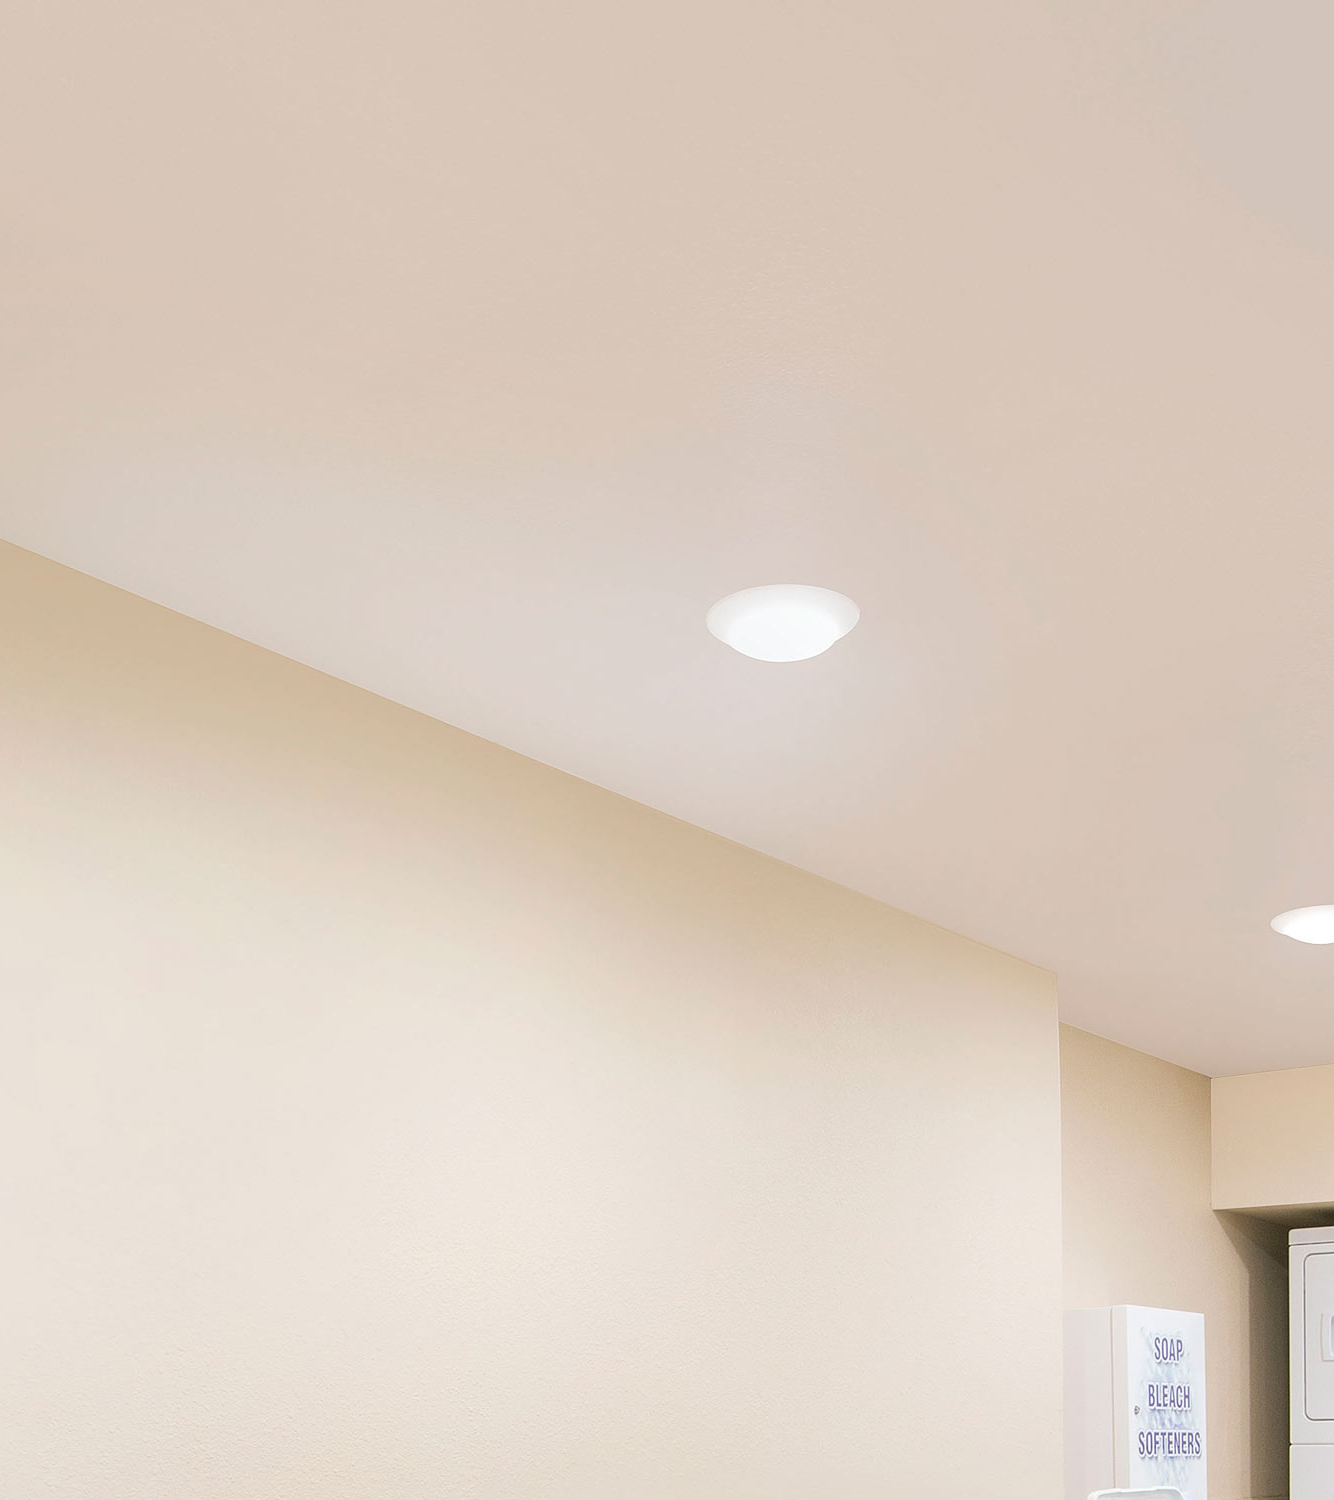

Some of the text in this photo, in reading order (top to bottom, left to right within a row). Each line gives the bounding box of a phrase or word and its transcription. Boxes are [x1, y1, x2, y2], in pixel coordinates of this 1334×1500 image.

[1154, 1336, 1183, 1361] SOAP
[1148, 1384, 1190, 1408] BLEACH
[1138, 1431, 1201, 1455] SOFTENERS
